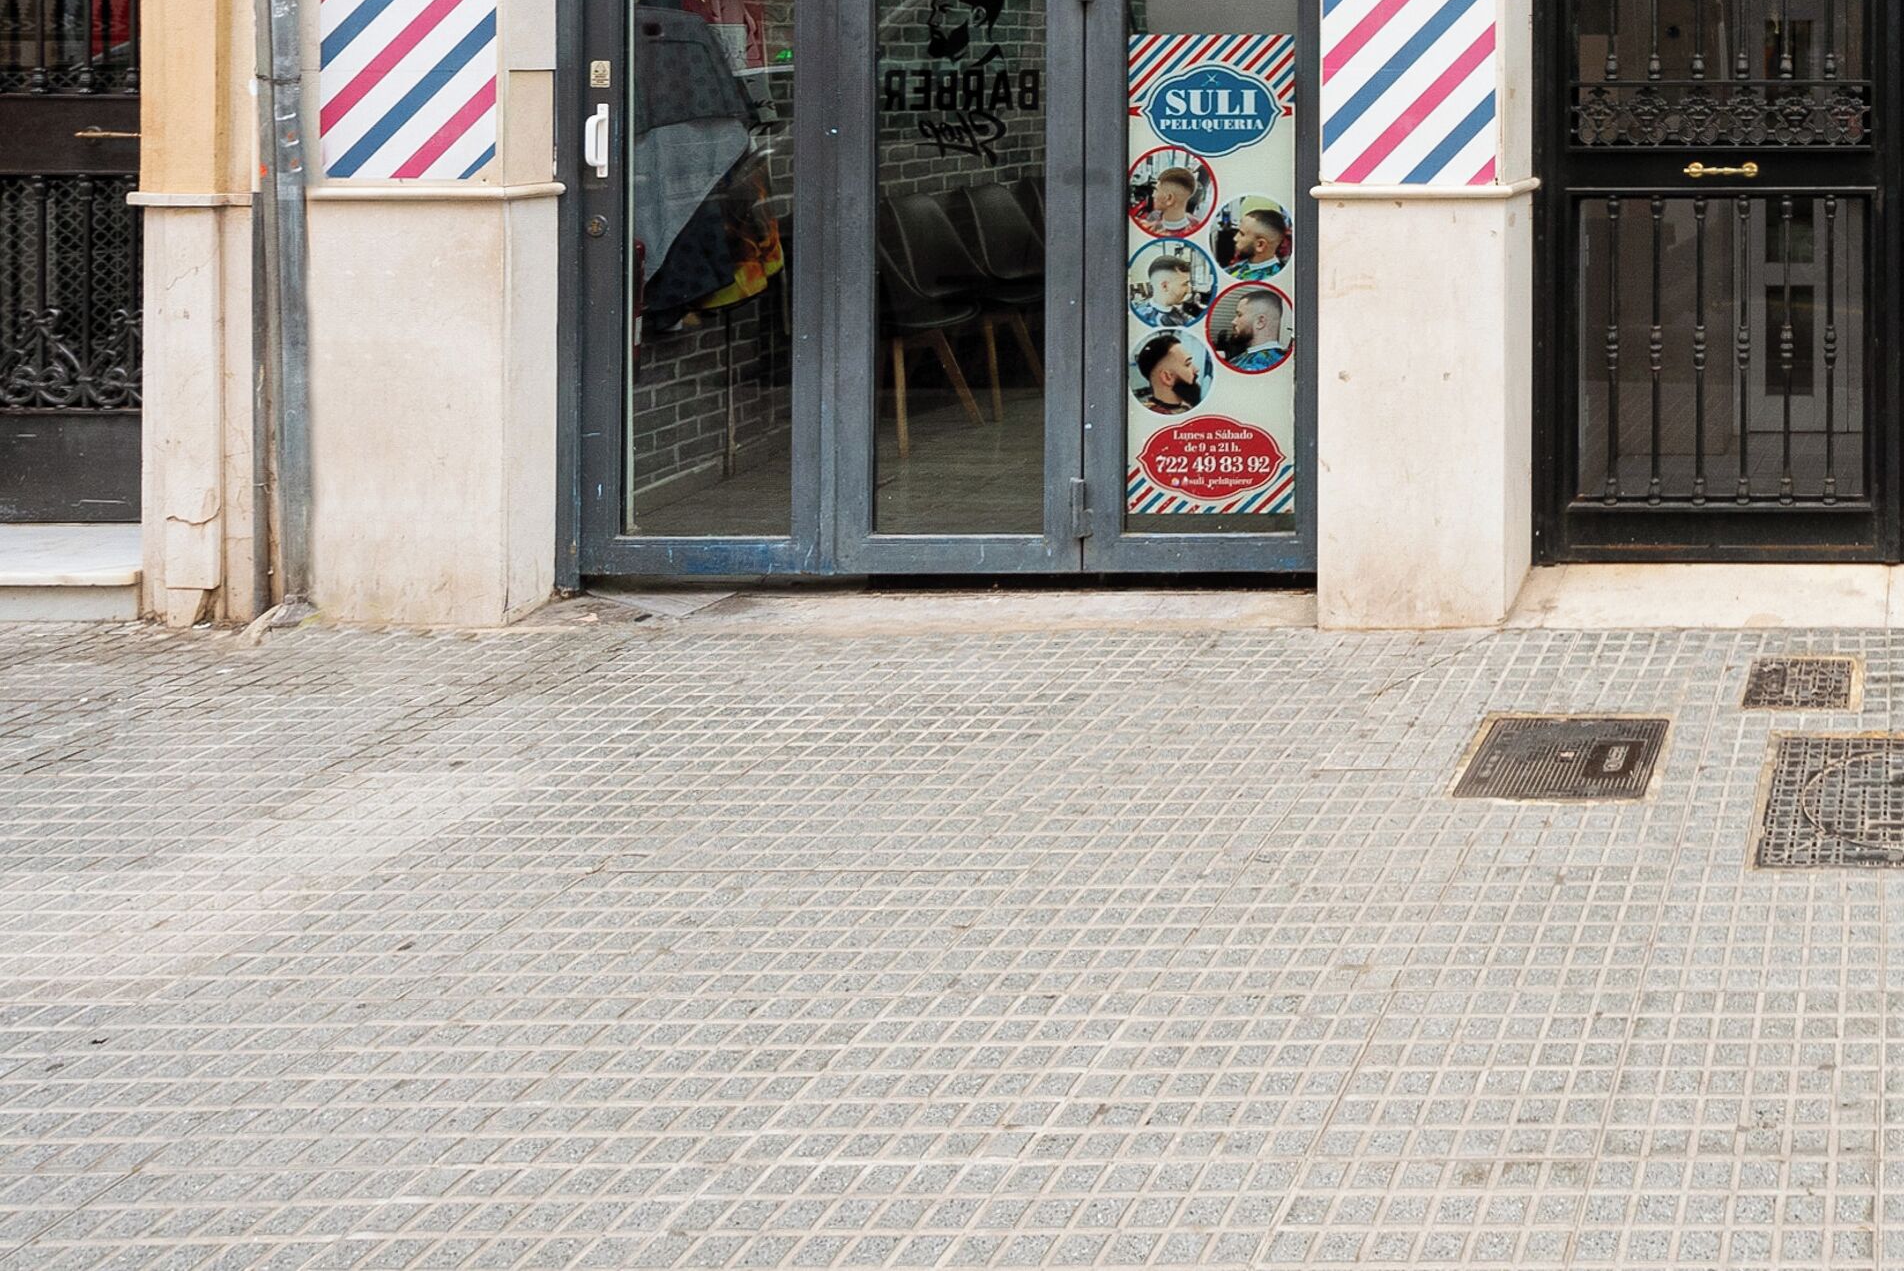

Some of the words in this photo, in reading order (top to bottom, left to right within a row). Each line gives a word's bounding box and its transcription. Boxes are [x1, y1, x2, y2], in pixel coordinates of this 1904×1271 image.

[1165, 89, 1258, 116] SULI
[1160, 119, 1264, 132] PELUQUERIA
[1173, 430, 1205, 441] Lunes
[1214, 430, 1253, 440] Sábado
[1184, 443, 1198, 452] de
[1218, 443, 1230, 452] 21
[1155, 455, 1189, 473] 722
[1192, 456, 1216, 473] 49
[1219, 455, 1244, 473] 83
[1247, 456, 1271, 473] 92
